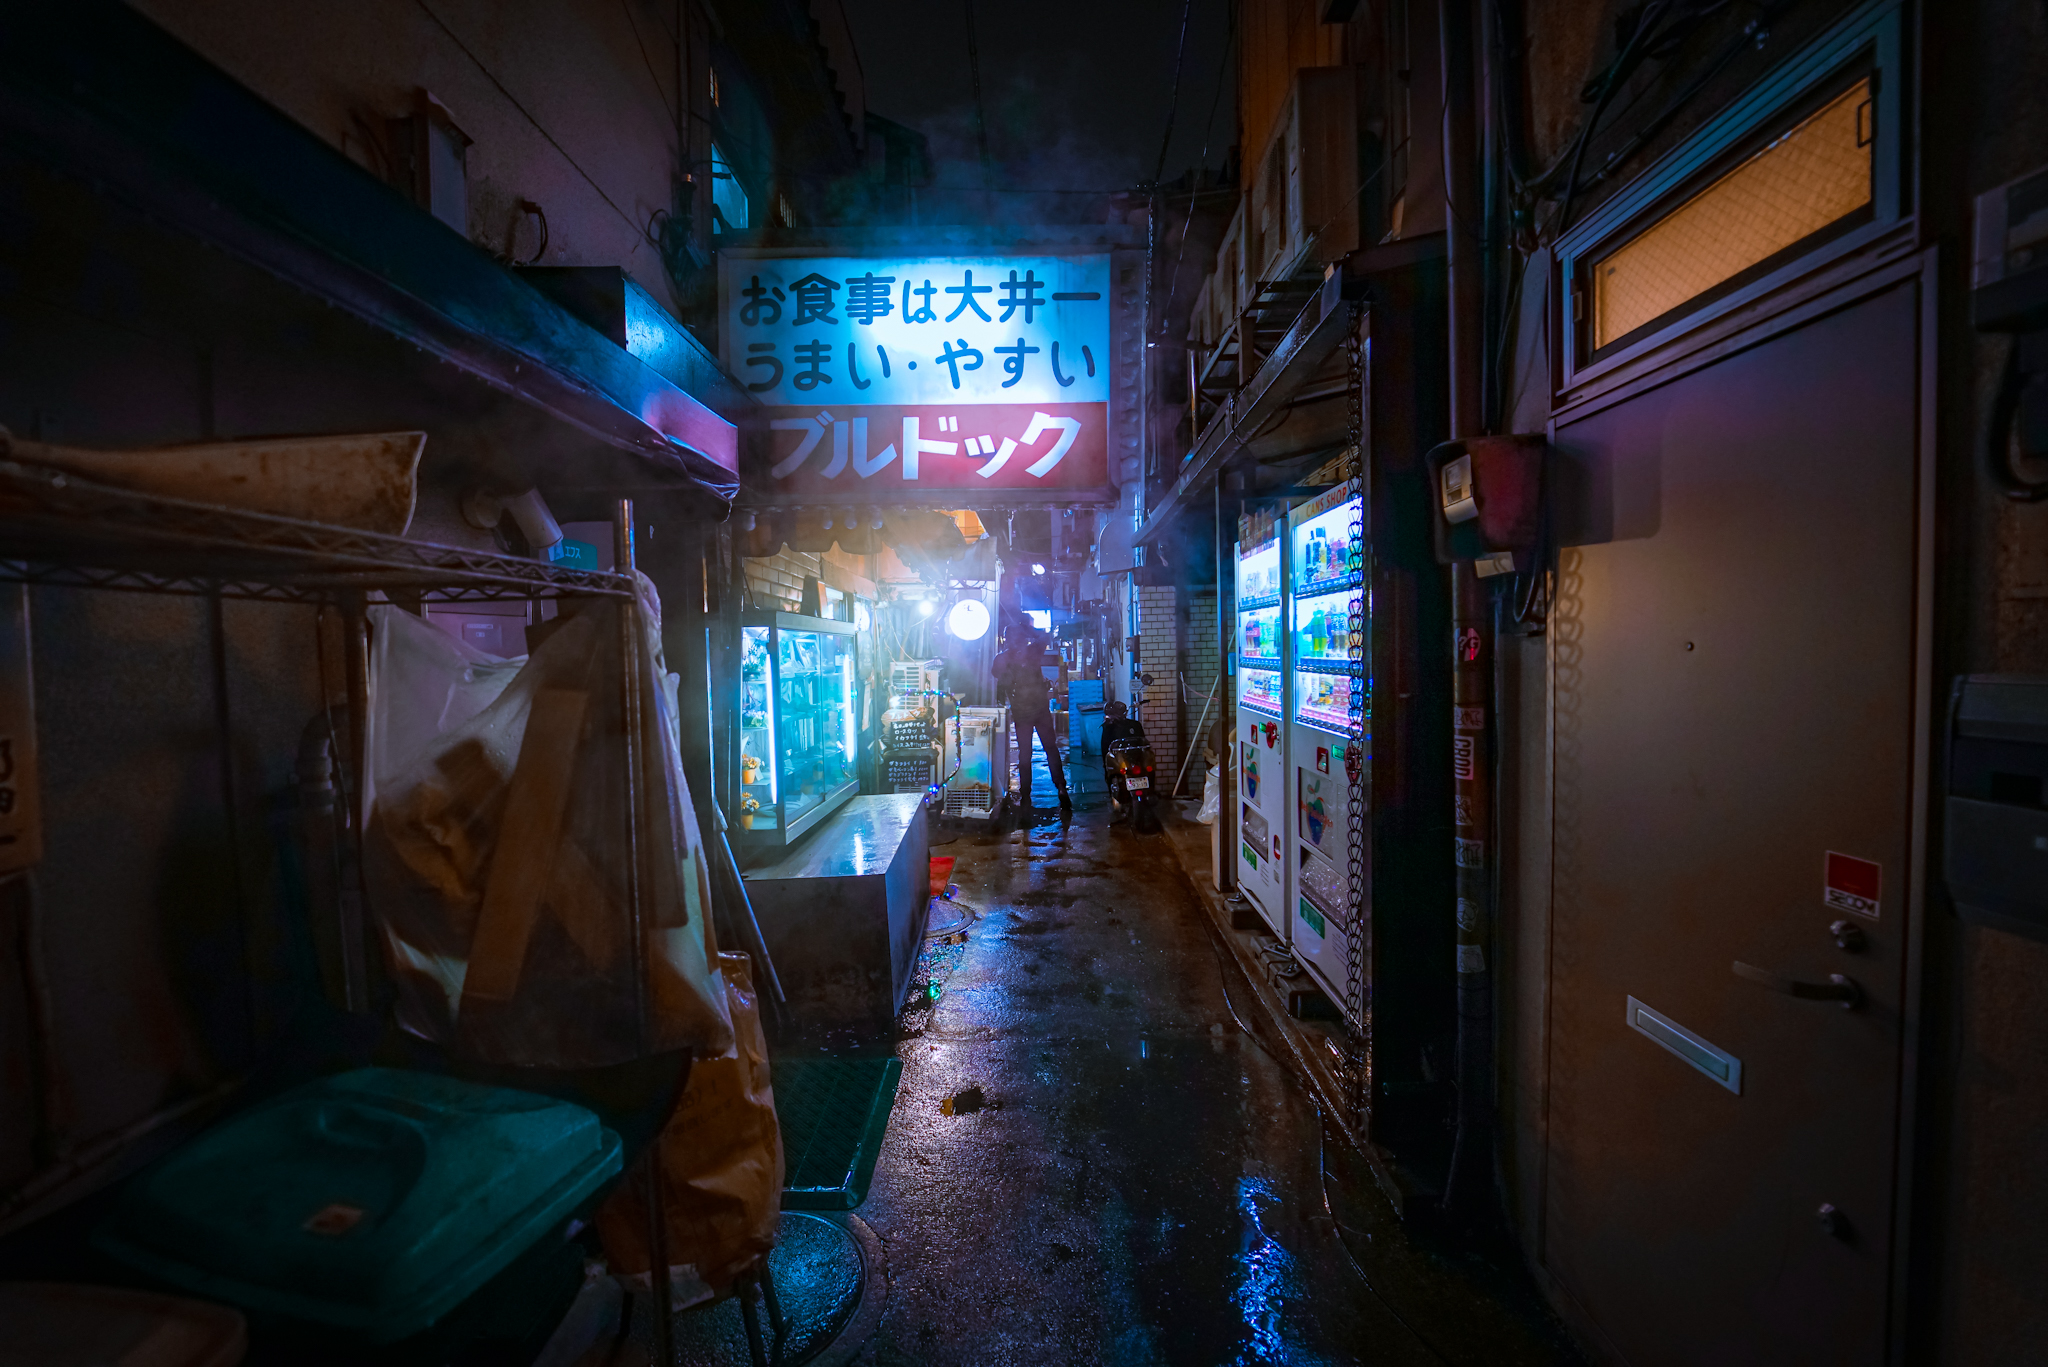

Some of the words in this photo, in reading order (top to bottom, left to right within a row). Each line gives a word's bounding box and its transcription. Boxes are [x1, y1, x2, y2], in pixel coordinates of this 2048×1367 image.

[739, 269, 1101, 327] お食事は大井一
[745, 337, 1096, 392] うまい・やすい
[769, 410, 1082, 481] ブルドック
[1326, 486, 1347, 509] SHOP
